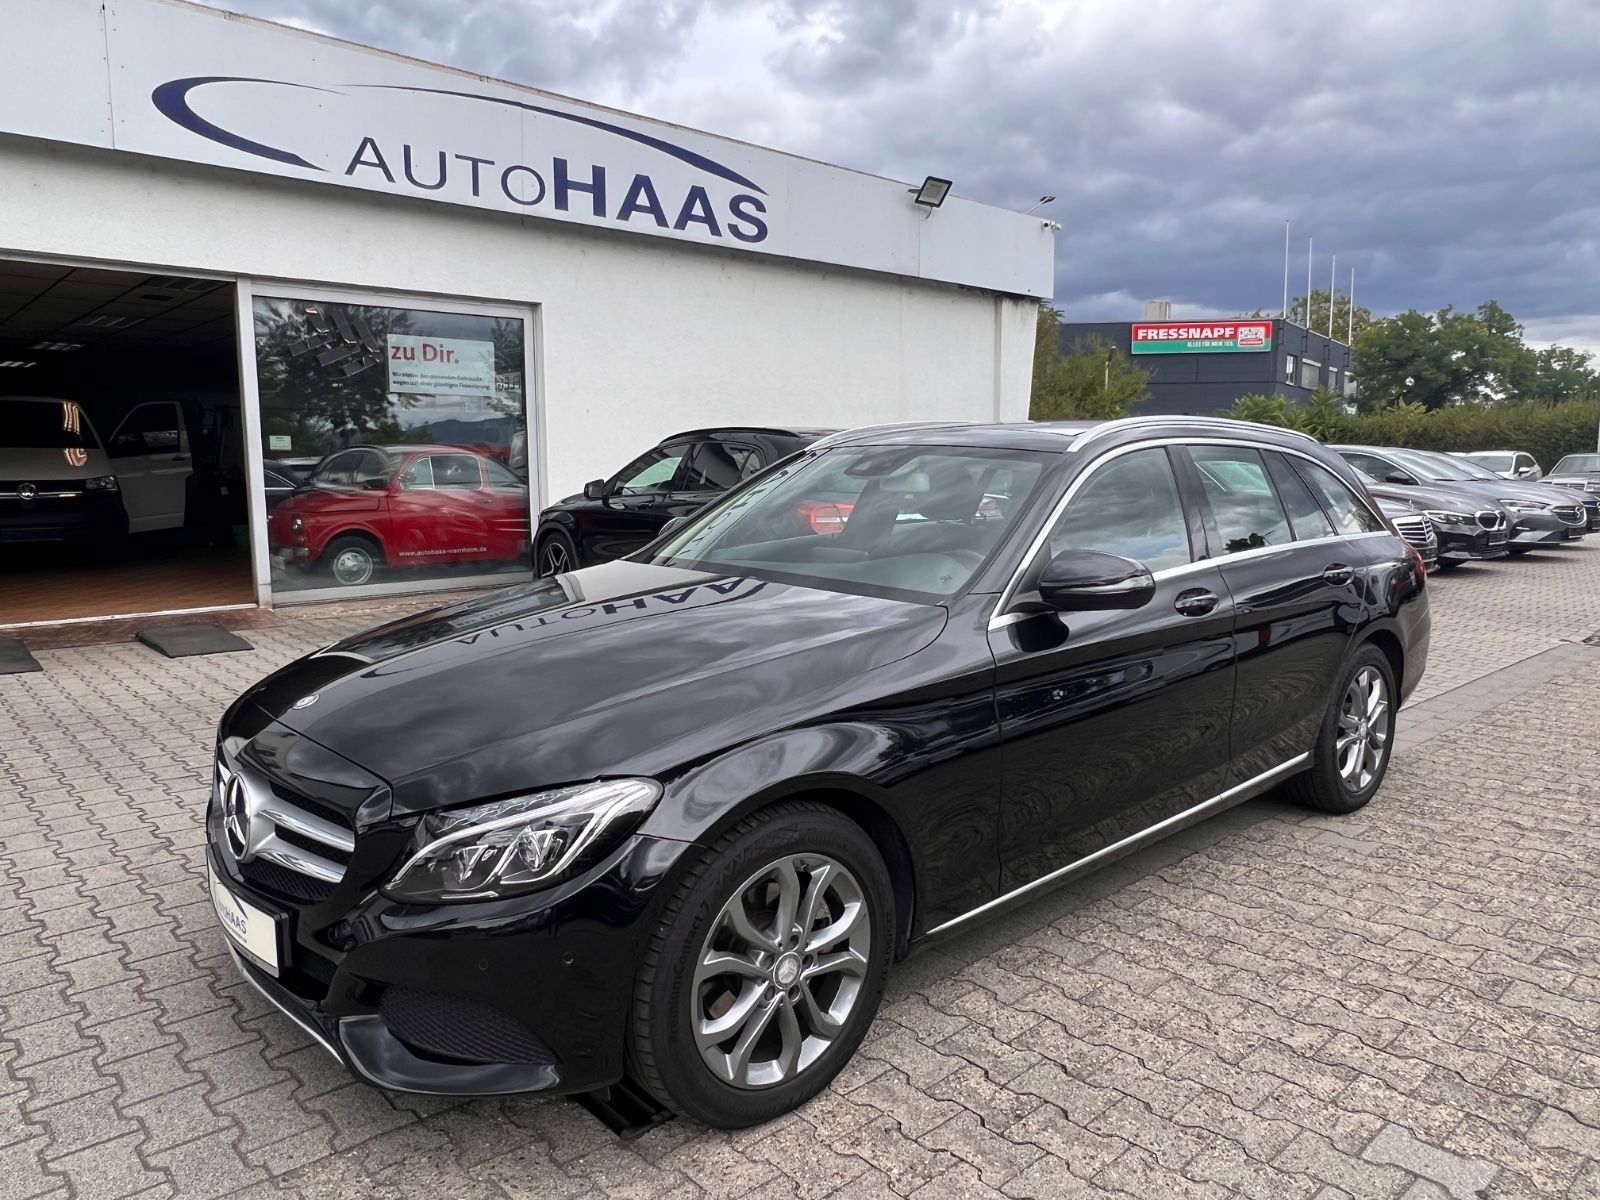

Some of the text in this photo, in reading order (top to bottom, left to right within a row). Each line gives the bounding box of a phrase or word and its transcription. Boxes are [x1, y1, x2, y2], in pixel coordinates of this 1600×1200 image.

[344, 136, 769, 244] AUTOHAAS
[1137, 327, 1234, 340] FRESSNAPF
[391, 343, 459, 364] zu Dir.
